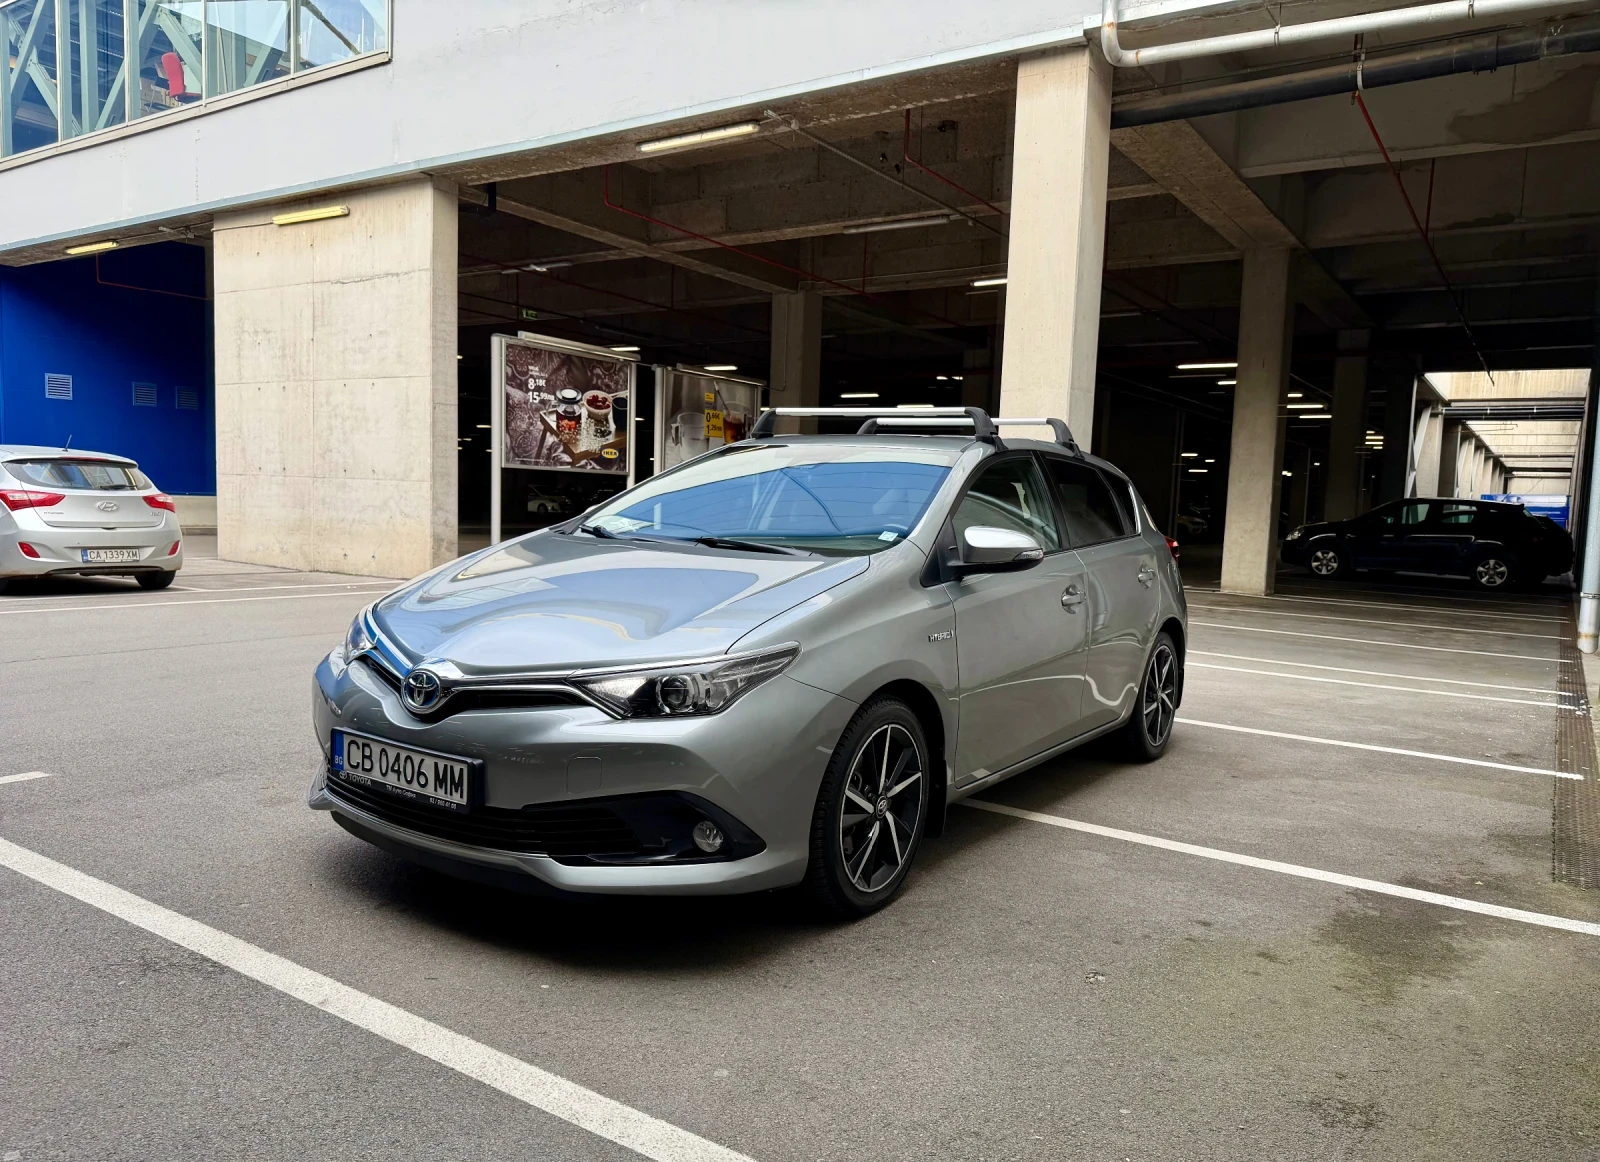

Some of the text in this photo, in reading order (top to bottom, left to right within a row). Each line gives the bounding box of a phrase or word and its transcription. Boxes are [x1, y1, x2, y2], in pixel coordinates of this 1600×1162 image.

[89, 550, 138, 560] CA 1339 XM
[928, 628, 954, 643] HYBRID
[334, 754, 343, 765] BG
[347, 739, 464, 799] CB 0406 MM
[348, 773, 372, 786] TOYOTA
